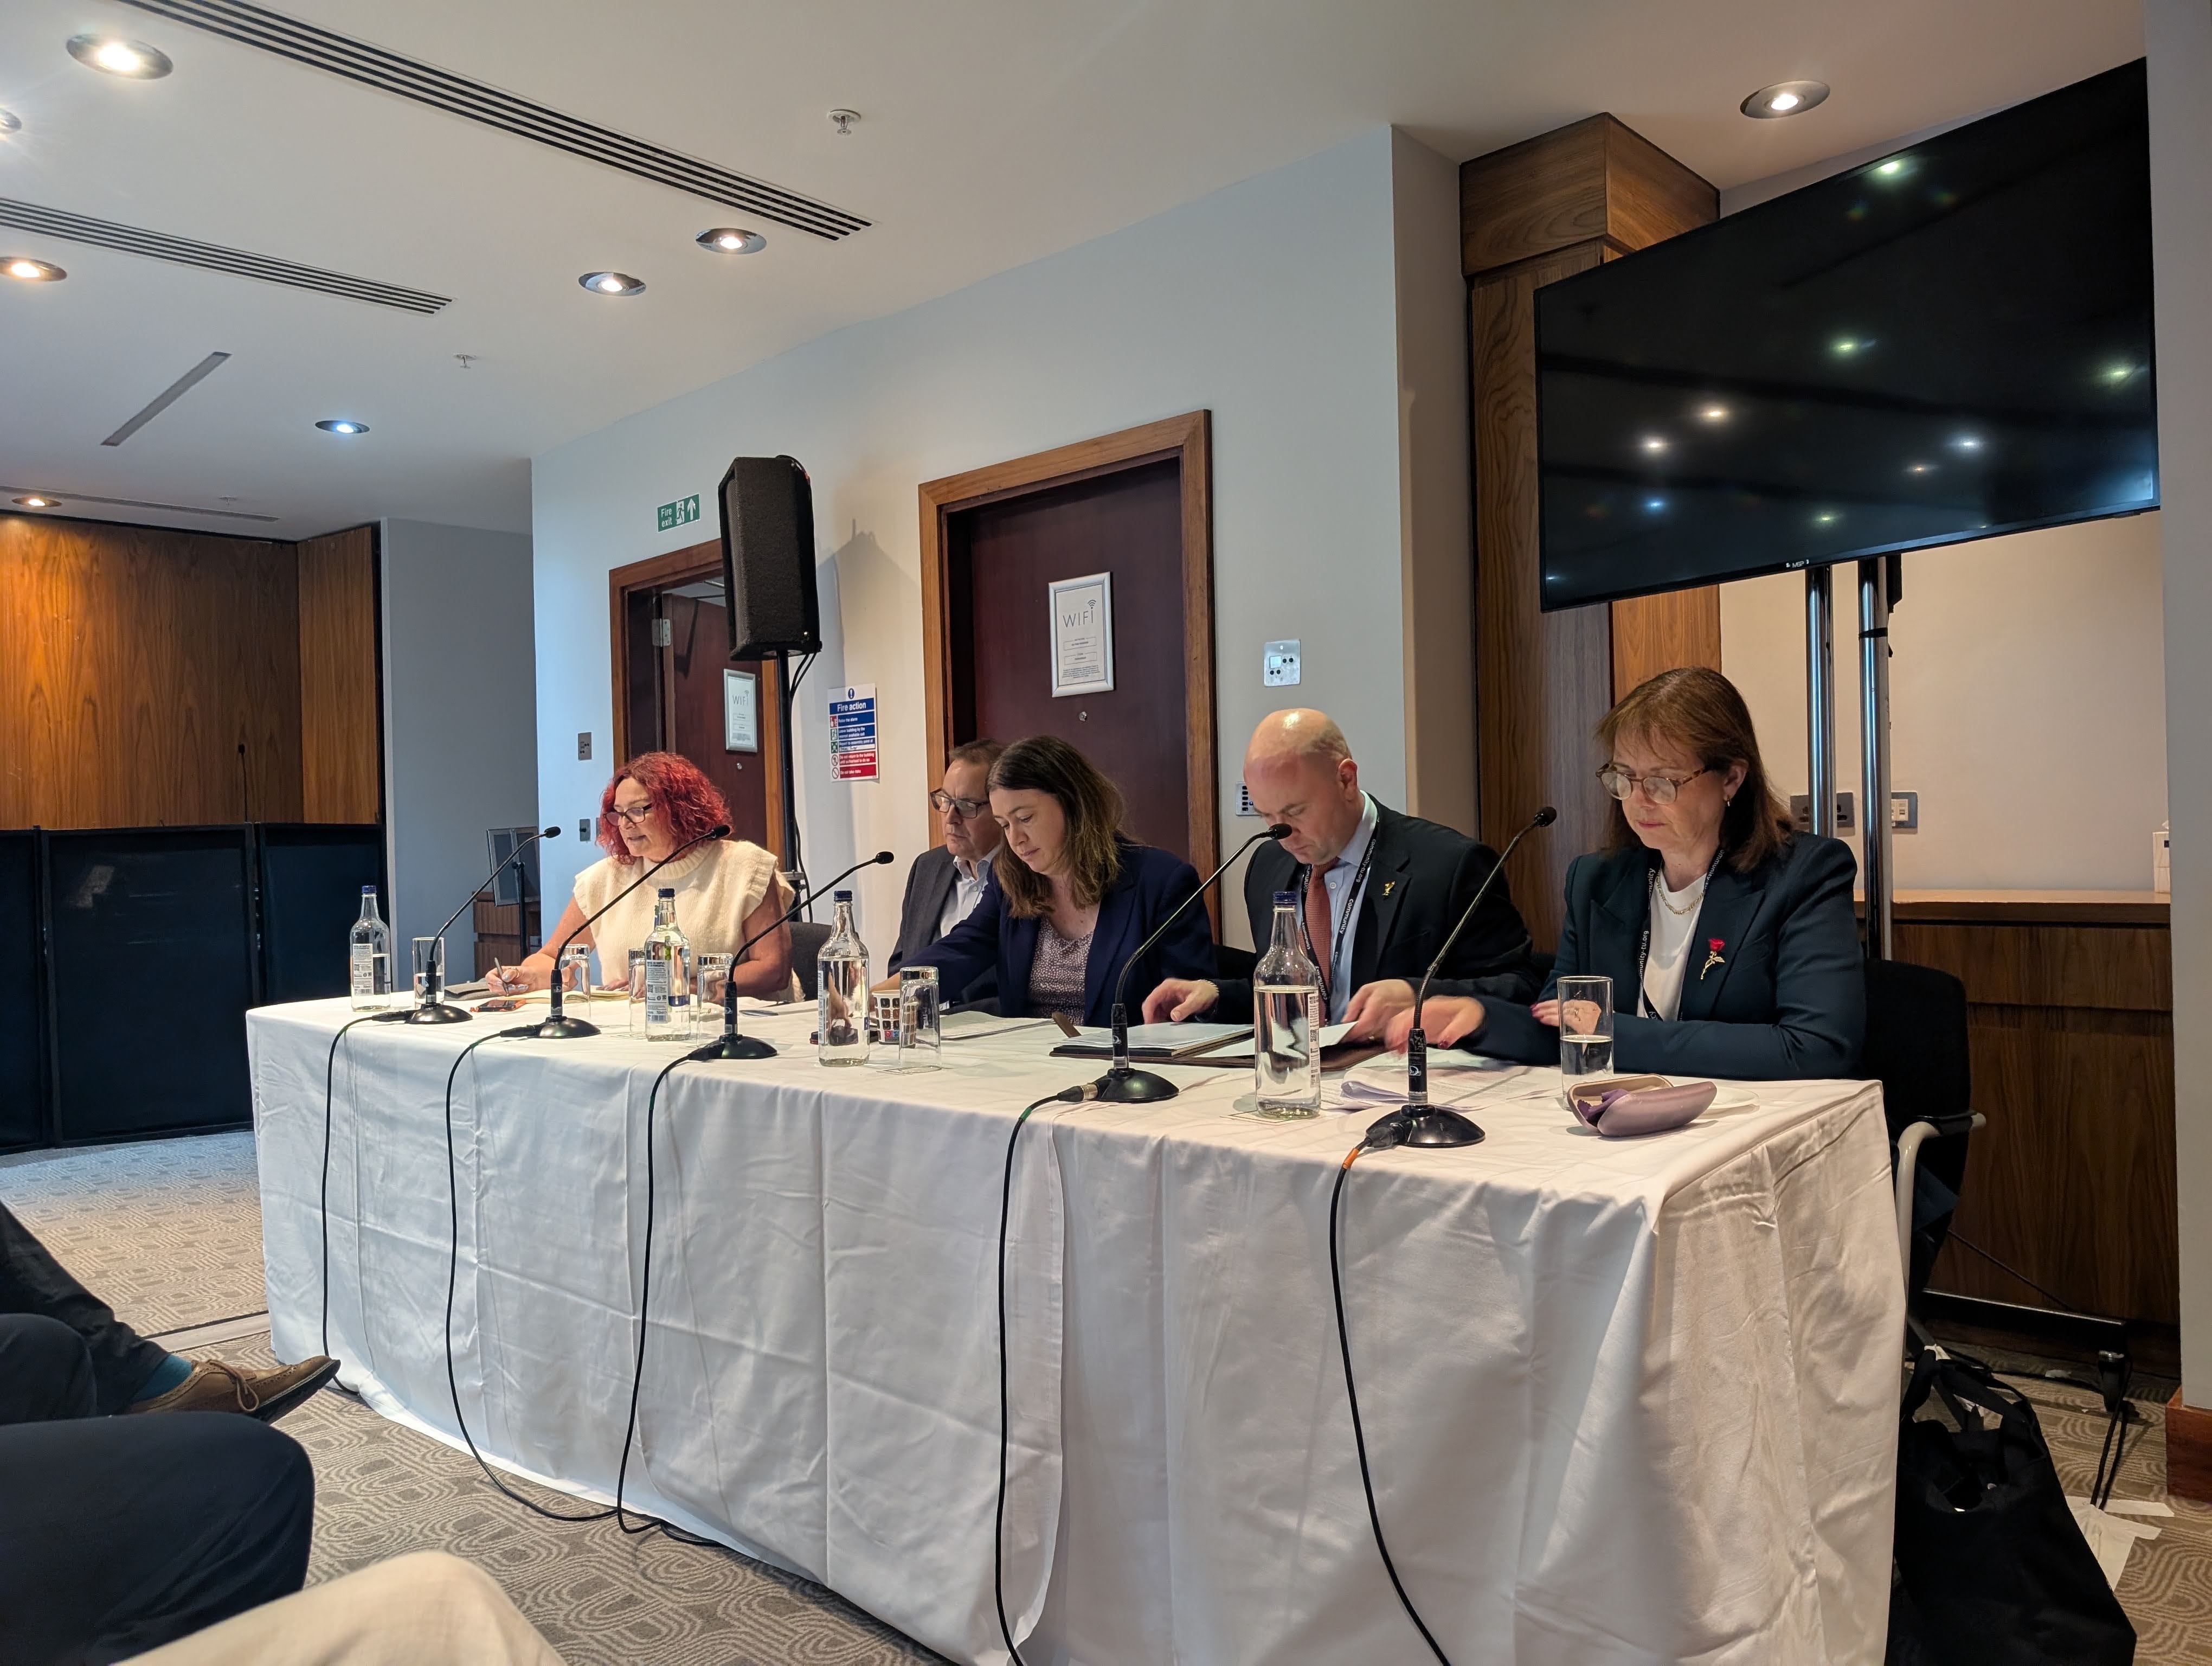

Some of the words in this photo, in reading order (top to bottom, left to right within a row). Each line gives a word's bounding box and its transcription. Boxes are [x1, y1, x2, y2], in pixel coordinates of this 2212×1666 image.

[661, 508, 672, 517] Fire
[661, 517, 672, 527] exit
[837, 703, 848, 712] Fire
[849, 701, 866, 710] action
[1356, 838, 1376, 883] community-tu.org
[1339, 898, 1354, 934] community
